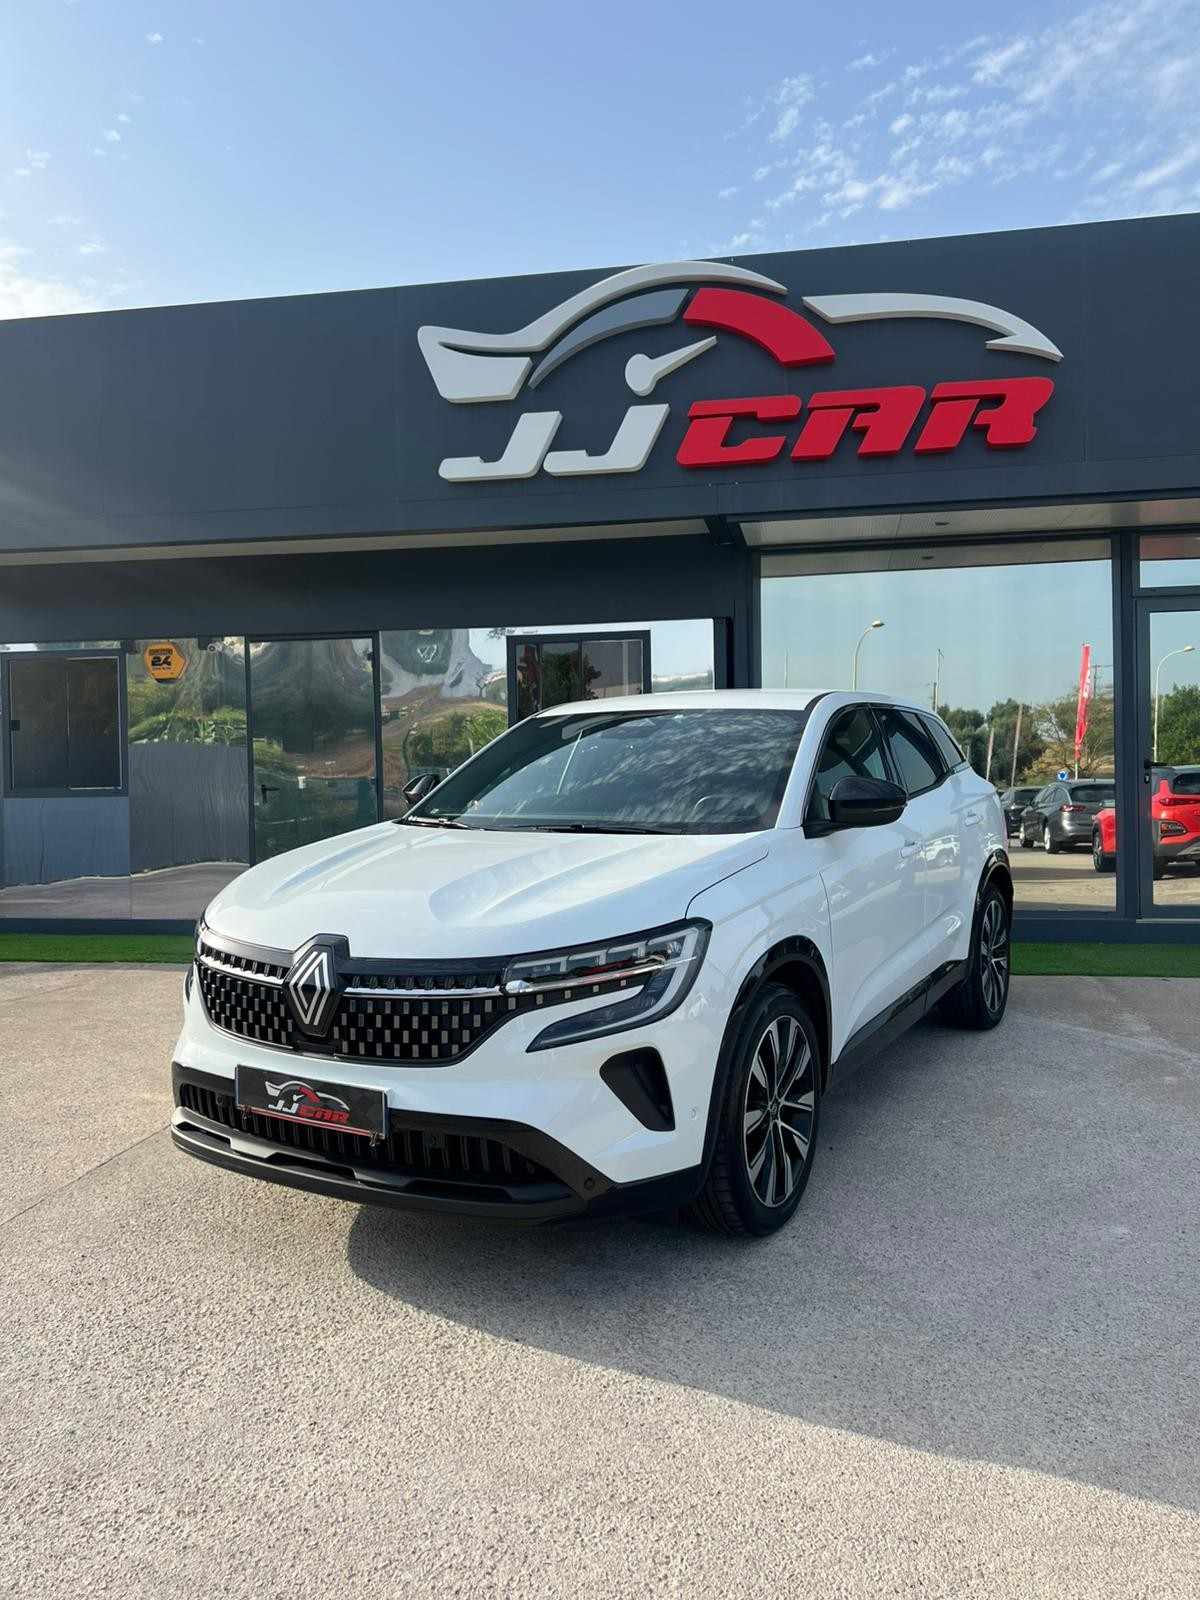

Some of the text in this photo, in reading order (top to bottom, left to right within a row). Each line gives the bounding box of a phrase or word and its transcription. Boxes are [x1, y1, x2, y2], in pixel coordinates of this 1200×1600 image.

[439, 377, 1055, 480] JJ CAR
[268, 1099, 350, 1123] JJ CAR
